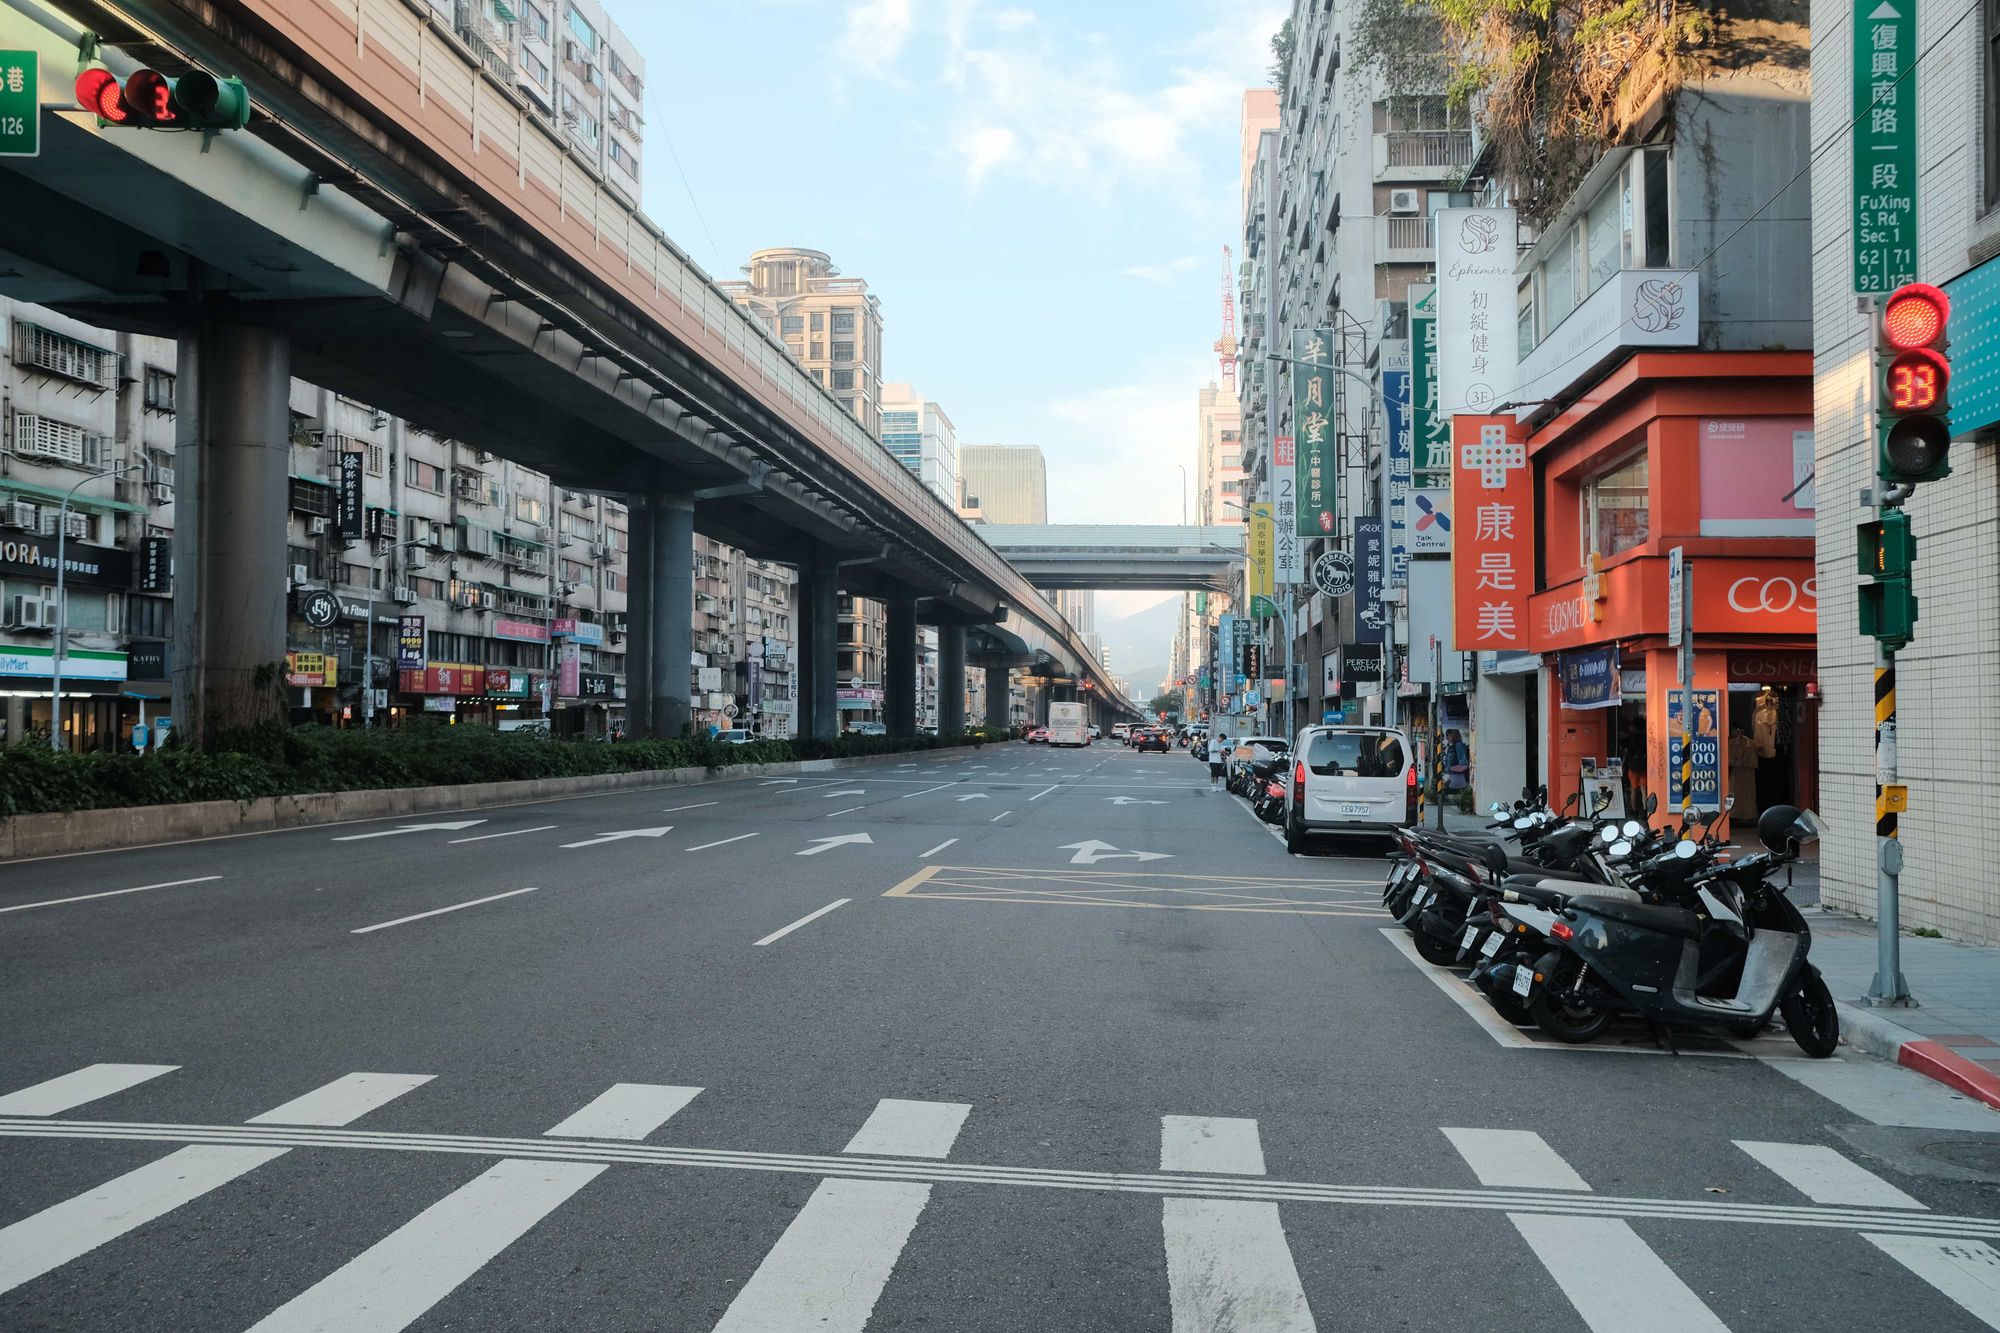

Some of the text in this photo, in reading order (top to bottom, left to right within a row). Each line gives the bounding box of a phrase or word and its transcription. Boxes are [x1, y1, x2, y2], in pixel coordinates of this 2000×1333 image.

[1871, 24, 1898, 189] 復興南路一段
[2, 117, 24, 135] 126
[1860, 195, 1910, 213] FuXing
[1860, 211, 1900, 226] S. Rd.
[1860, 228, 1900, 243] Sec. 1
[1860, 249, 1880, 265] 62
[1893, 248, 1910, 264] 71
[1860, 274, 1880, 290] 92
[1895, 365, 1935, 408] 33
[1472, 391, 1488, 403] 3F
[0, 541, 40, 565] ORA
[1320, 553, 1353, 567] PERFECT
[1474, 502, 1517, 641] 康是美
[1321, 583, 1351, 593] STUDIO
[1727, 576, 1817, 613] COS
[1549, 597, 1588, 635] COSMED
